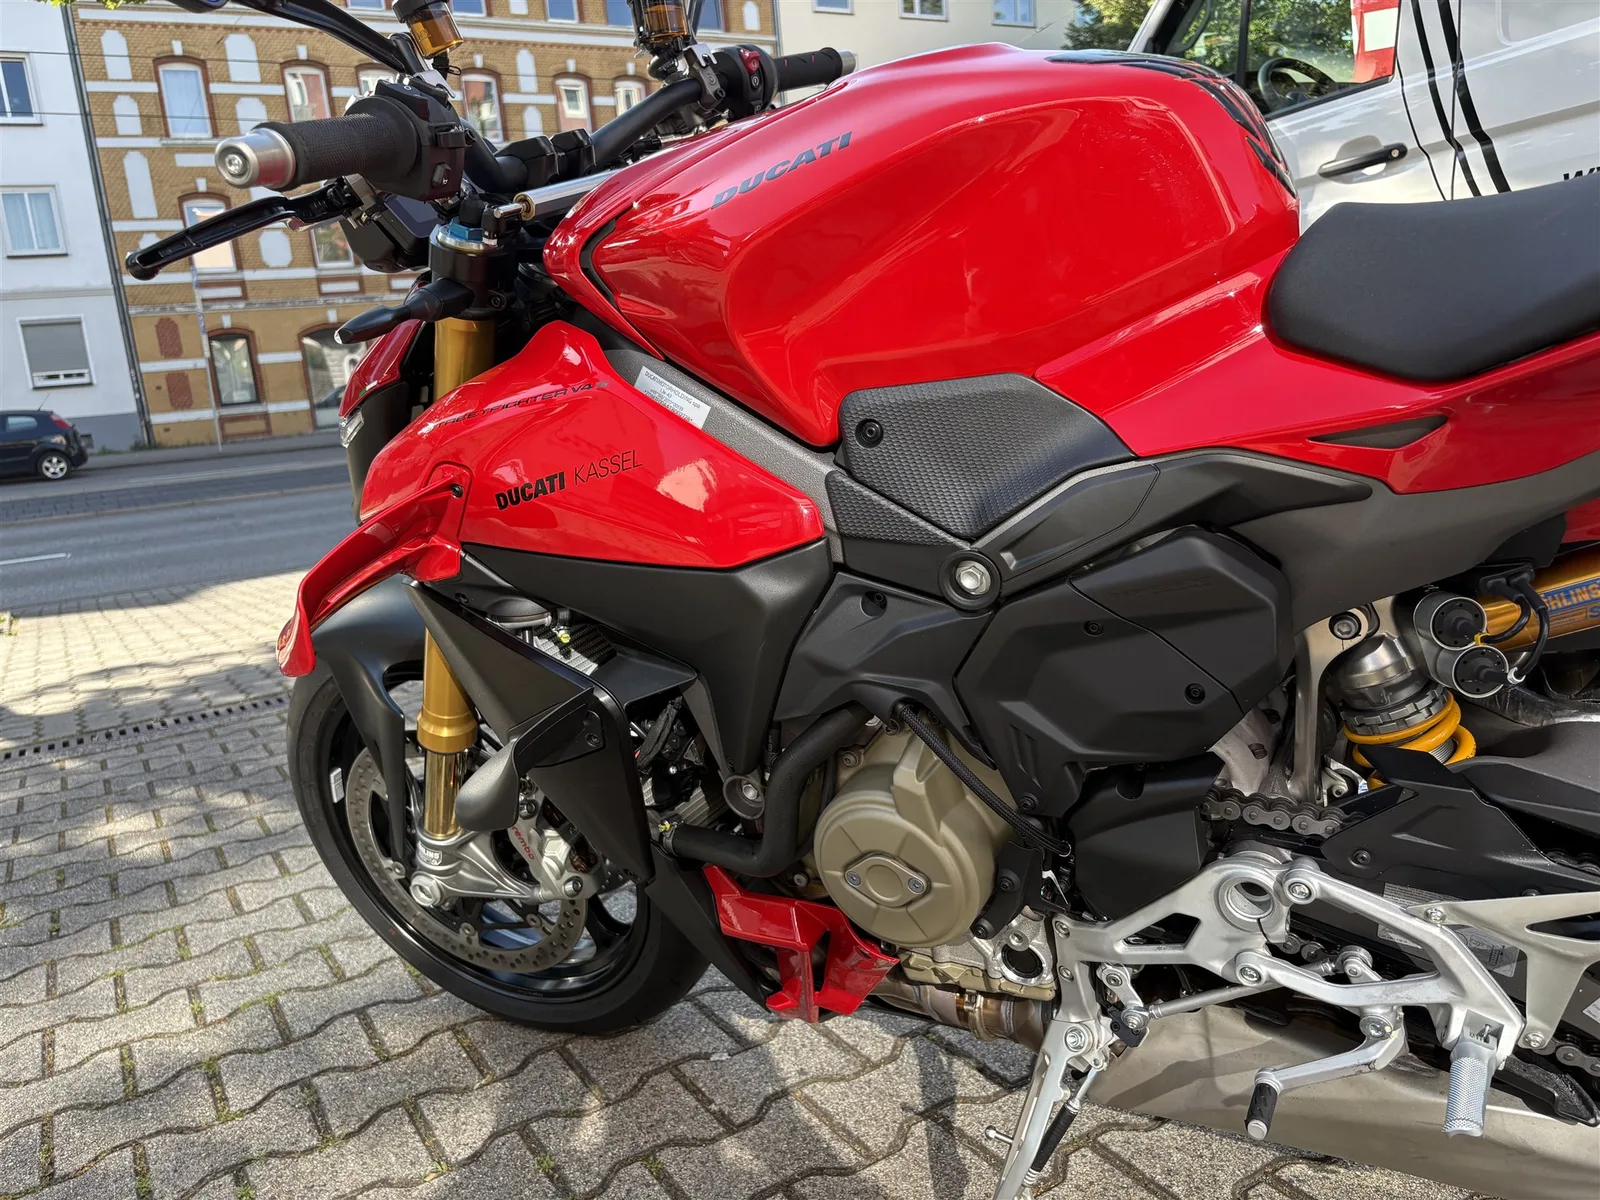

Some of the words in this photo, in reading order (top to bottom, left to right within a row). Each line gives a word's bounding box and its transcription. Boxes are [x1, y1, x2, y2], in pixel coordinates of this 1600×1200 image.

[711, 131, 852, 210] DUCATI
[428, 389, 568, 431] TREETFIGHTER
[571, 383, 593, 393] V4
[495, 471, 566, 511] DUCATI
[574, 449, 643, 486] KASSEL
